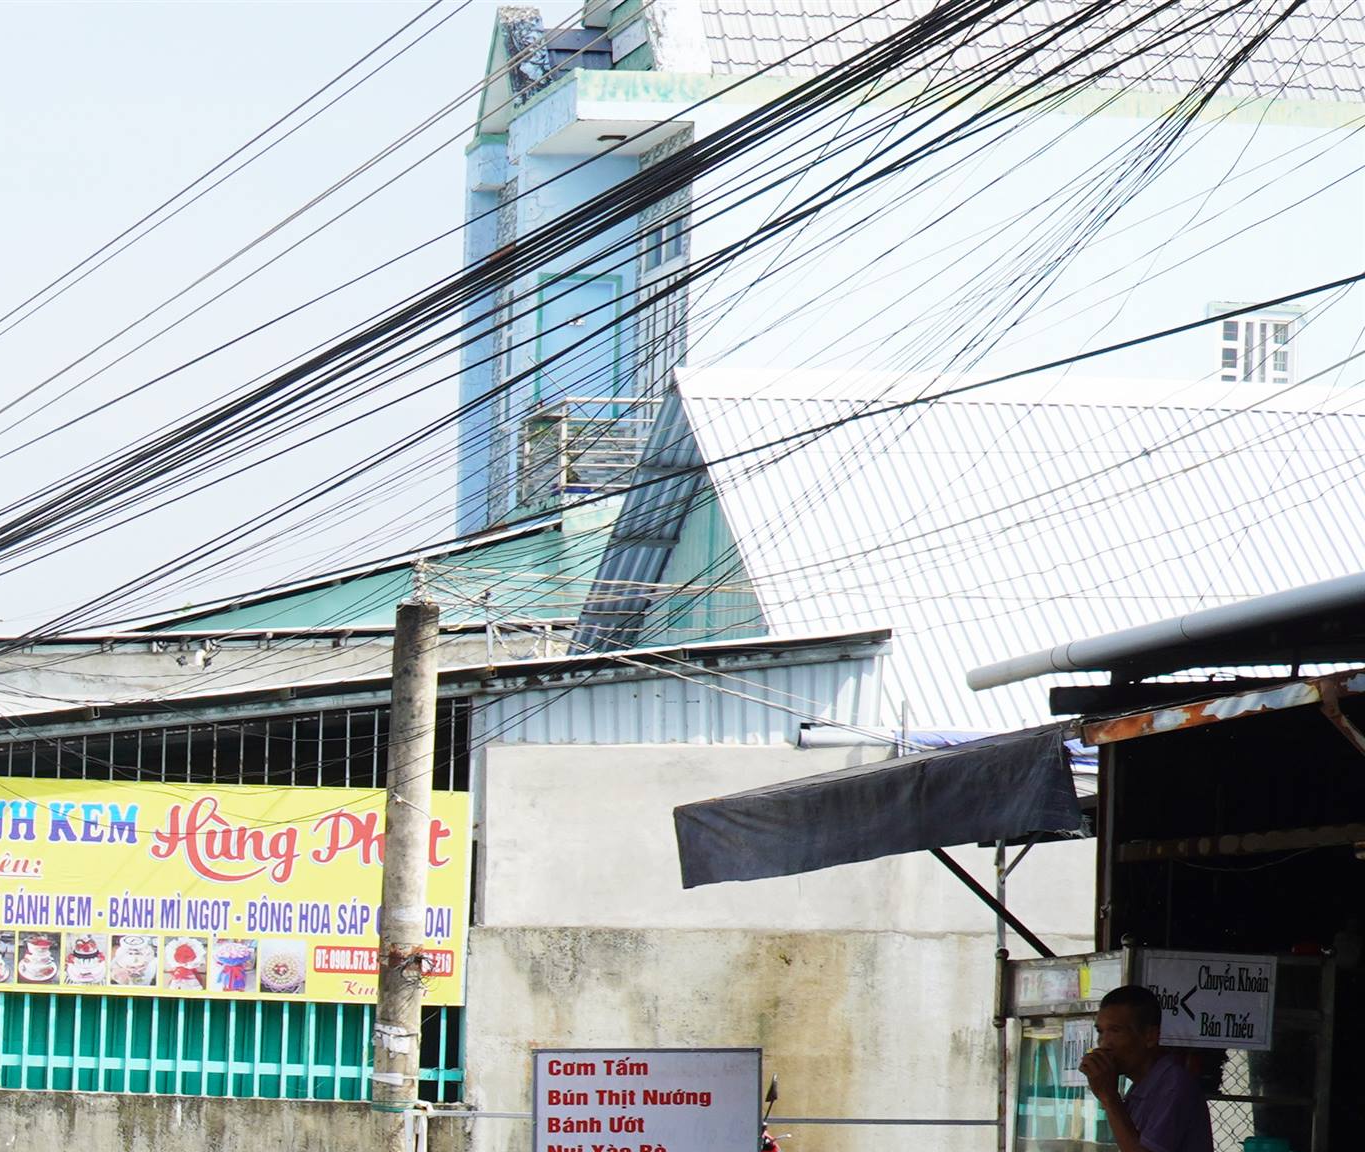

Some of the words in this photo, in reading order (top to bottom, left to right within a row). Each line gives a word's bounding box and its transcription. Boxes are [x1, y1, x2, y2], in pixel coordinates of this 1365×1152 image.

[48, 803, 139, 844] KEM
[151, 797, 300, 882] Hùng
[313, 809, 451, 867] Pht
[4, 888, 49, 925] BÁNH
[55, 896, 91, 927] KEM
[109, 891, 155, 928] BÁNH
[161, 893, 181, 929] MÌ
[187, 899, 230, 937] NGỌT
[248, 896, 292, 934] BÔNG
[299, 903, 330, 934] HOA
[337, 898, 369, 935] SÁP
[424, 907, 451, 944] OẠI
[329, 949, 378, 971] 0908.678.3
[1198, 964, 1234, 996] Chuyển
[1238, 967, 1269, 994] Khoản
[1200, 1012, 1221, 1037] Bán
[1224, 1006, 1254, 1039] Thiếu
[548, 1060, 595, 1076] Cơm
[603, 1057, 648, 1076] Tấm
[547, 1090, 588, 1106] Bún
[596, 1090, 636, 1109] Thịt
[643, 1089, 712, 1107] Nướng
[547, 1117, 601, 1133] Bánh
[609, 1115, 645, 1133] Ướt
